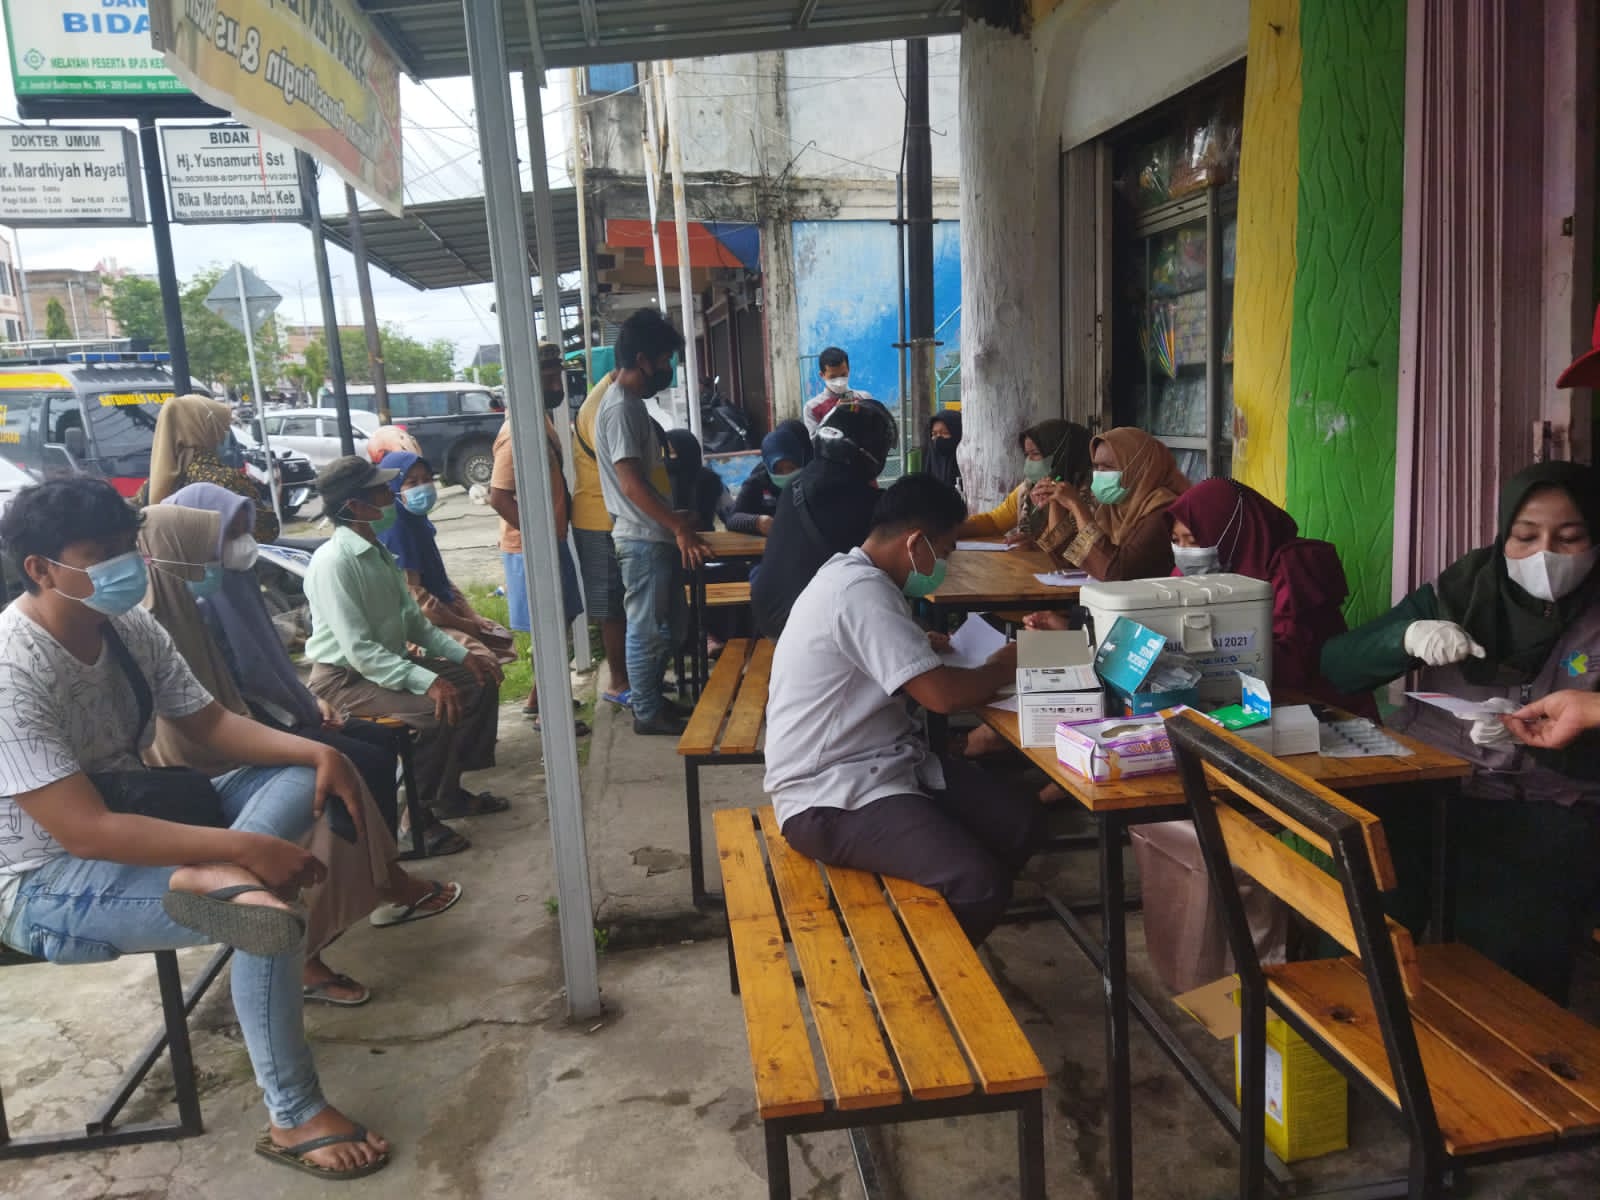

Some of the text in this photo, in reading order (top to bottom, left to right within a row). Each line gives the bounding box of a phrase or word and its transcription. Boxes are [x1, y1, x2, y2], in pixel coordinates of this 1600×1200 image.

[11, 135, 101, 147] DOKTER UMUM
[209, 131, 250, 144] BIDAN
[265, 151, 285, 166] Sst
[13, 162, 81, 181] Mardhiyah
[84, 162, 127, 181] Hayati
[178, 192, 200, 206] Rika
[276, 190, 296, 204] Keb
[1224, 636, 1248, 647] 2021
